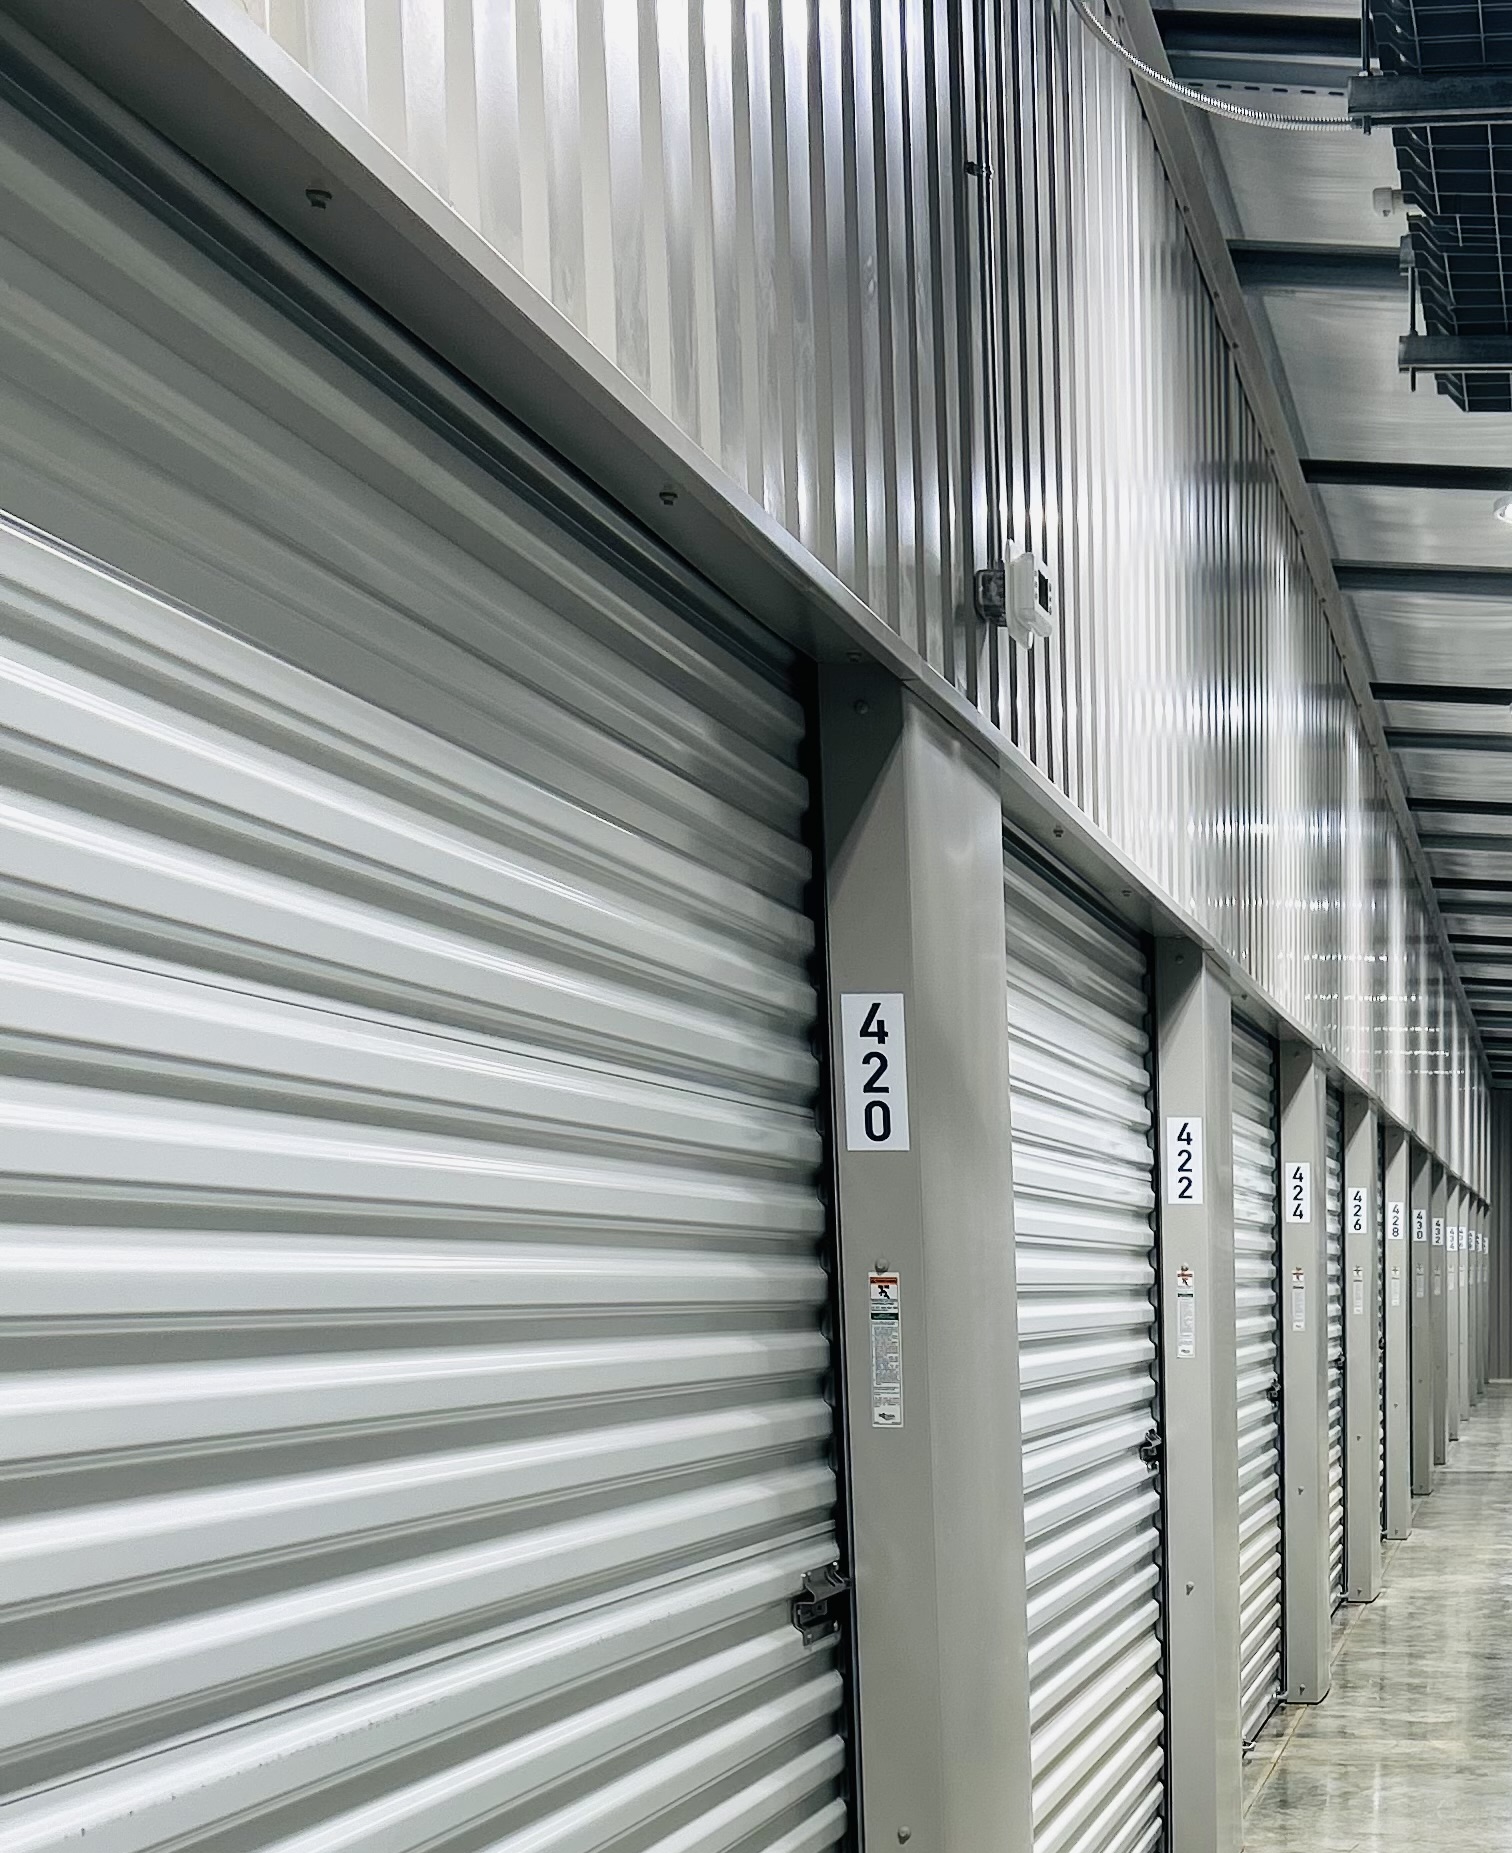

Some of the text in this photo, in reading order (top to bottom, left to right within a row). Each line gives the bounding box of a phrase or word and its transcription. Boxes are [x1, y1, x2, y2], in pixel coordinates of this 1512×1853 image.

[859, 1001, 892, 1144] 420
[1176, 1121, 1194, 1200] 422
[1292, 1165, 1304, 1221] 424
[1353, 1190, 1363, 1231] 426
[1392, 1204, 1400, 1237] 428
